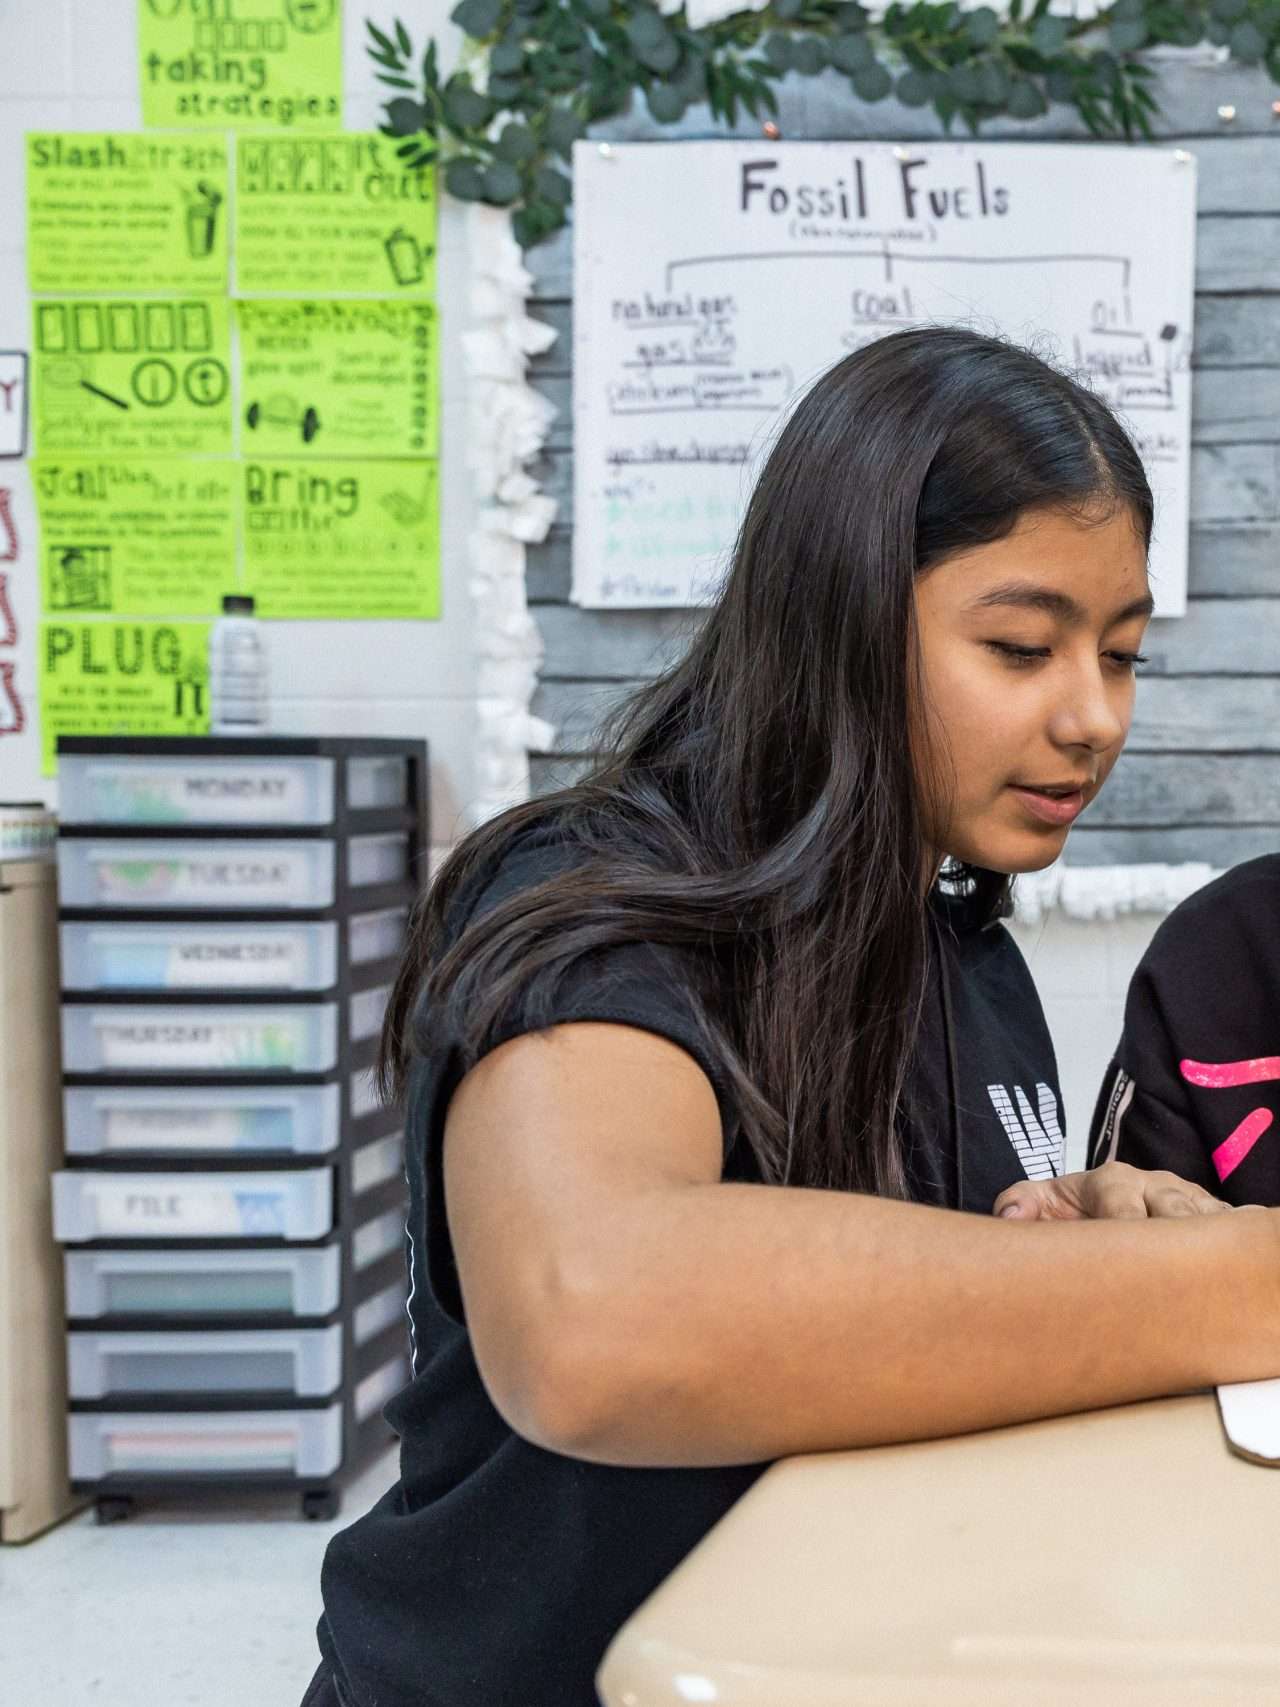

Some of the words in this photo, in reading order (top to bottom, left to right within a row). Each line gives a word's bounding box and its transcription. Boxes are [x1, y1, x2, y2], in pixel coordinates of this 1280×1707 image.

[147, 50, 268, 92] taking
[175, 93, 341, 126] strategies
[33, 137, 127, 169] Slash
[741, 158, 868, 220] Fossil
[899, 159, 1011, 220] Fuels
[246, 465, 360, 517] Bring
[46, 627, 182, 675] PLUG
